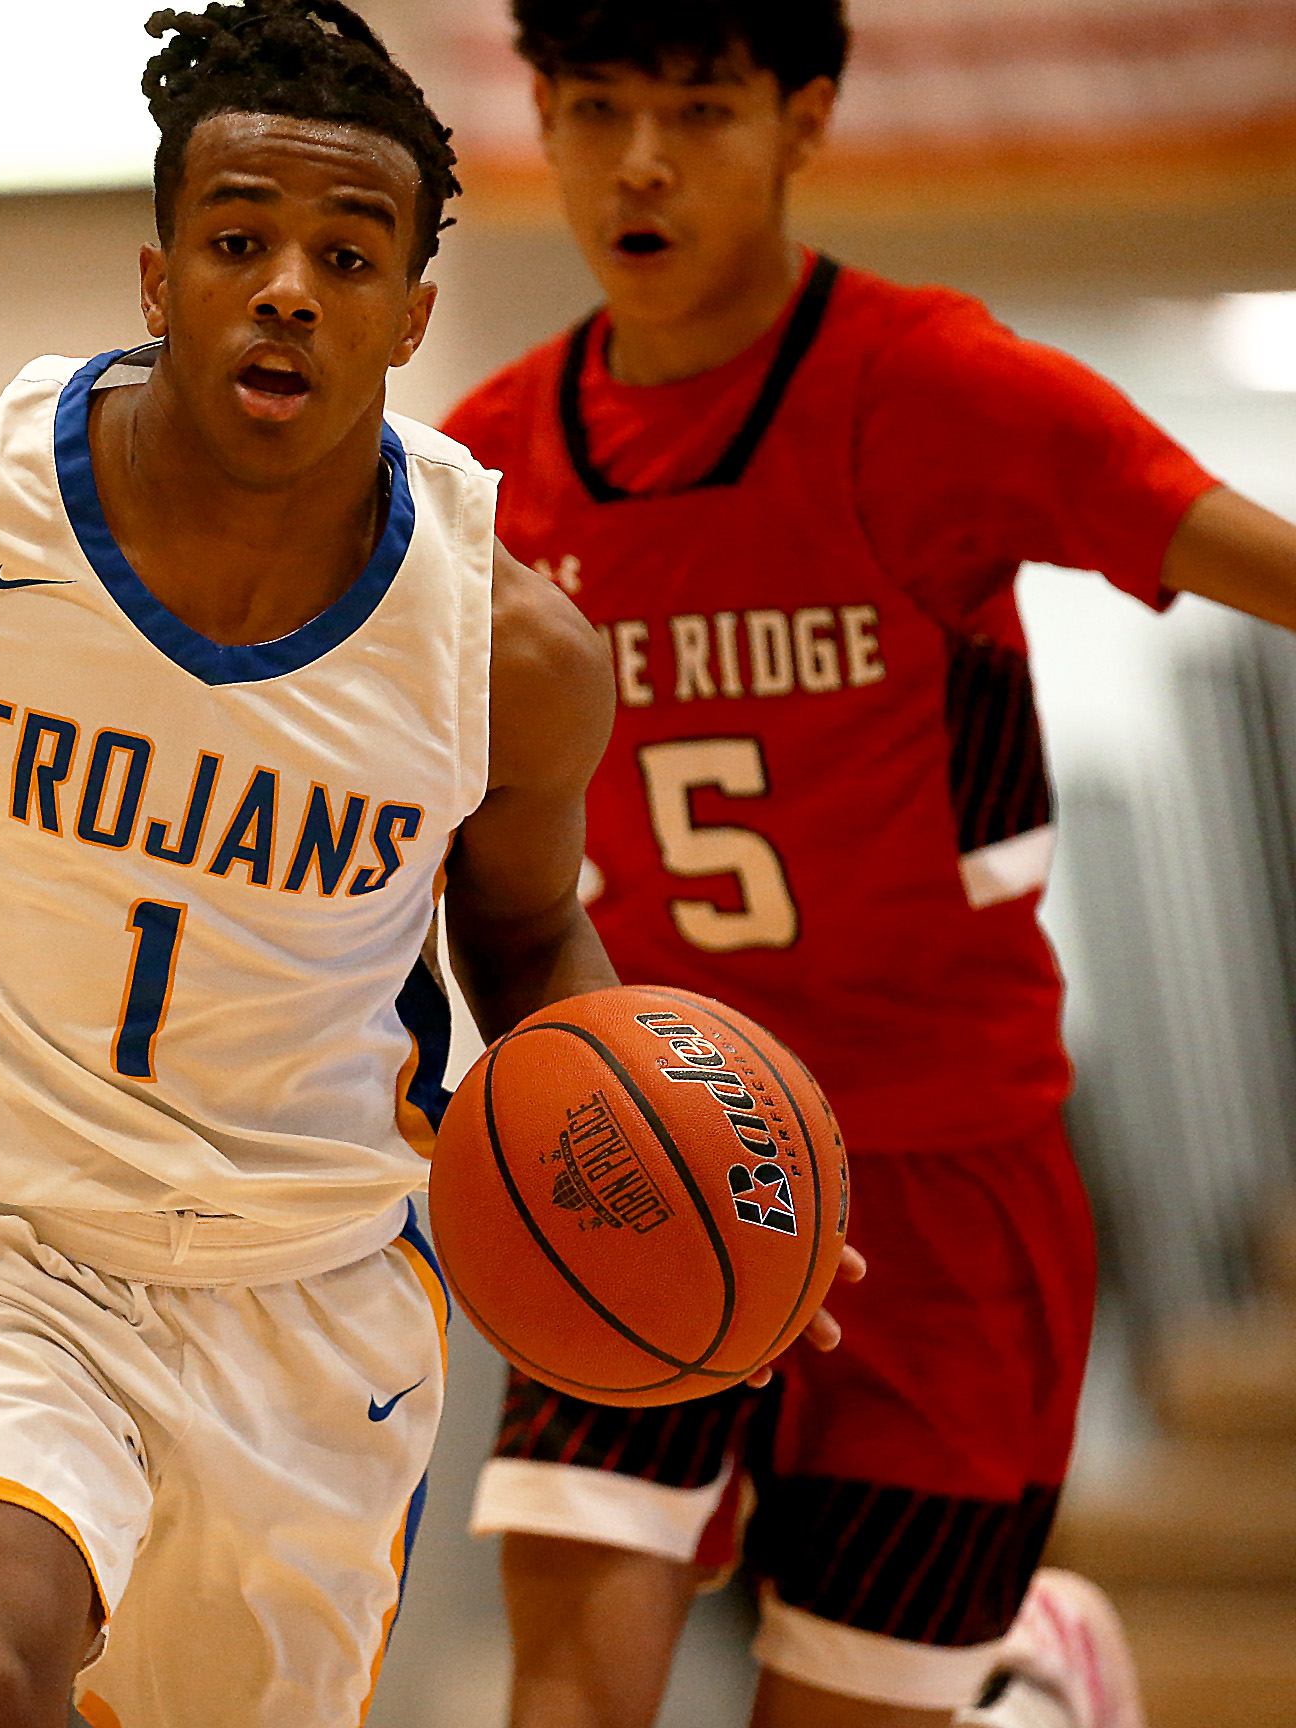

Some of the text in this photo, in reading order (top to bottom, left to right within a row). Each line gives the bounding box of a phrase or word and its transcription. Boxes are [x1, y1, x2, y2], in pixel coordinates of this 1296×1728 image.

[597, 604, 886, 707] E RIDGE
[637, 734, 797, 953] 5
[110, 897, 188, 1083] 1
[566, 1093, 669, 1234] CORN PALACE
[634, 1011, 797, 1236] Baden
